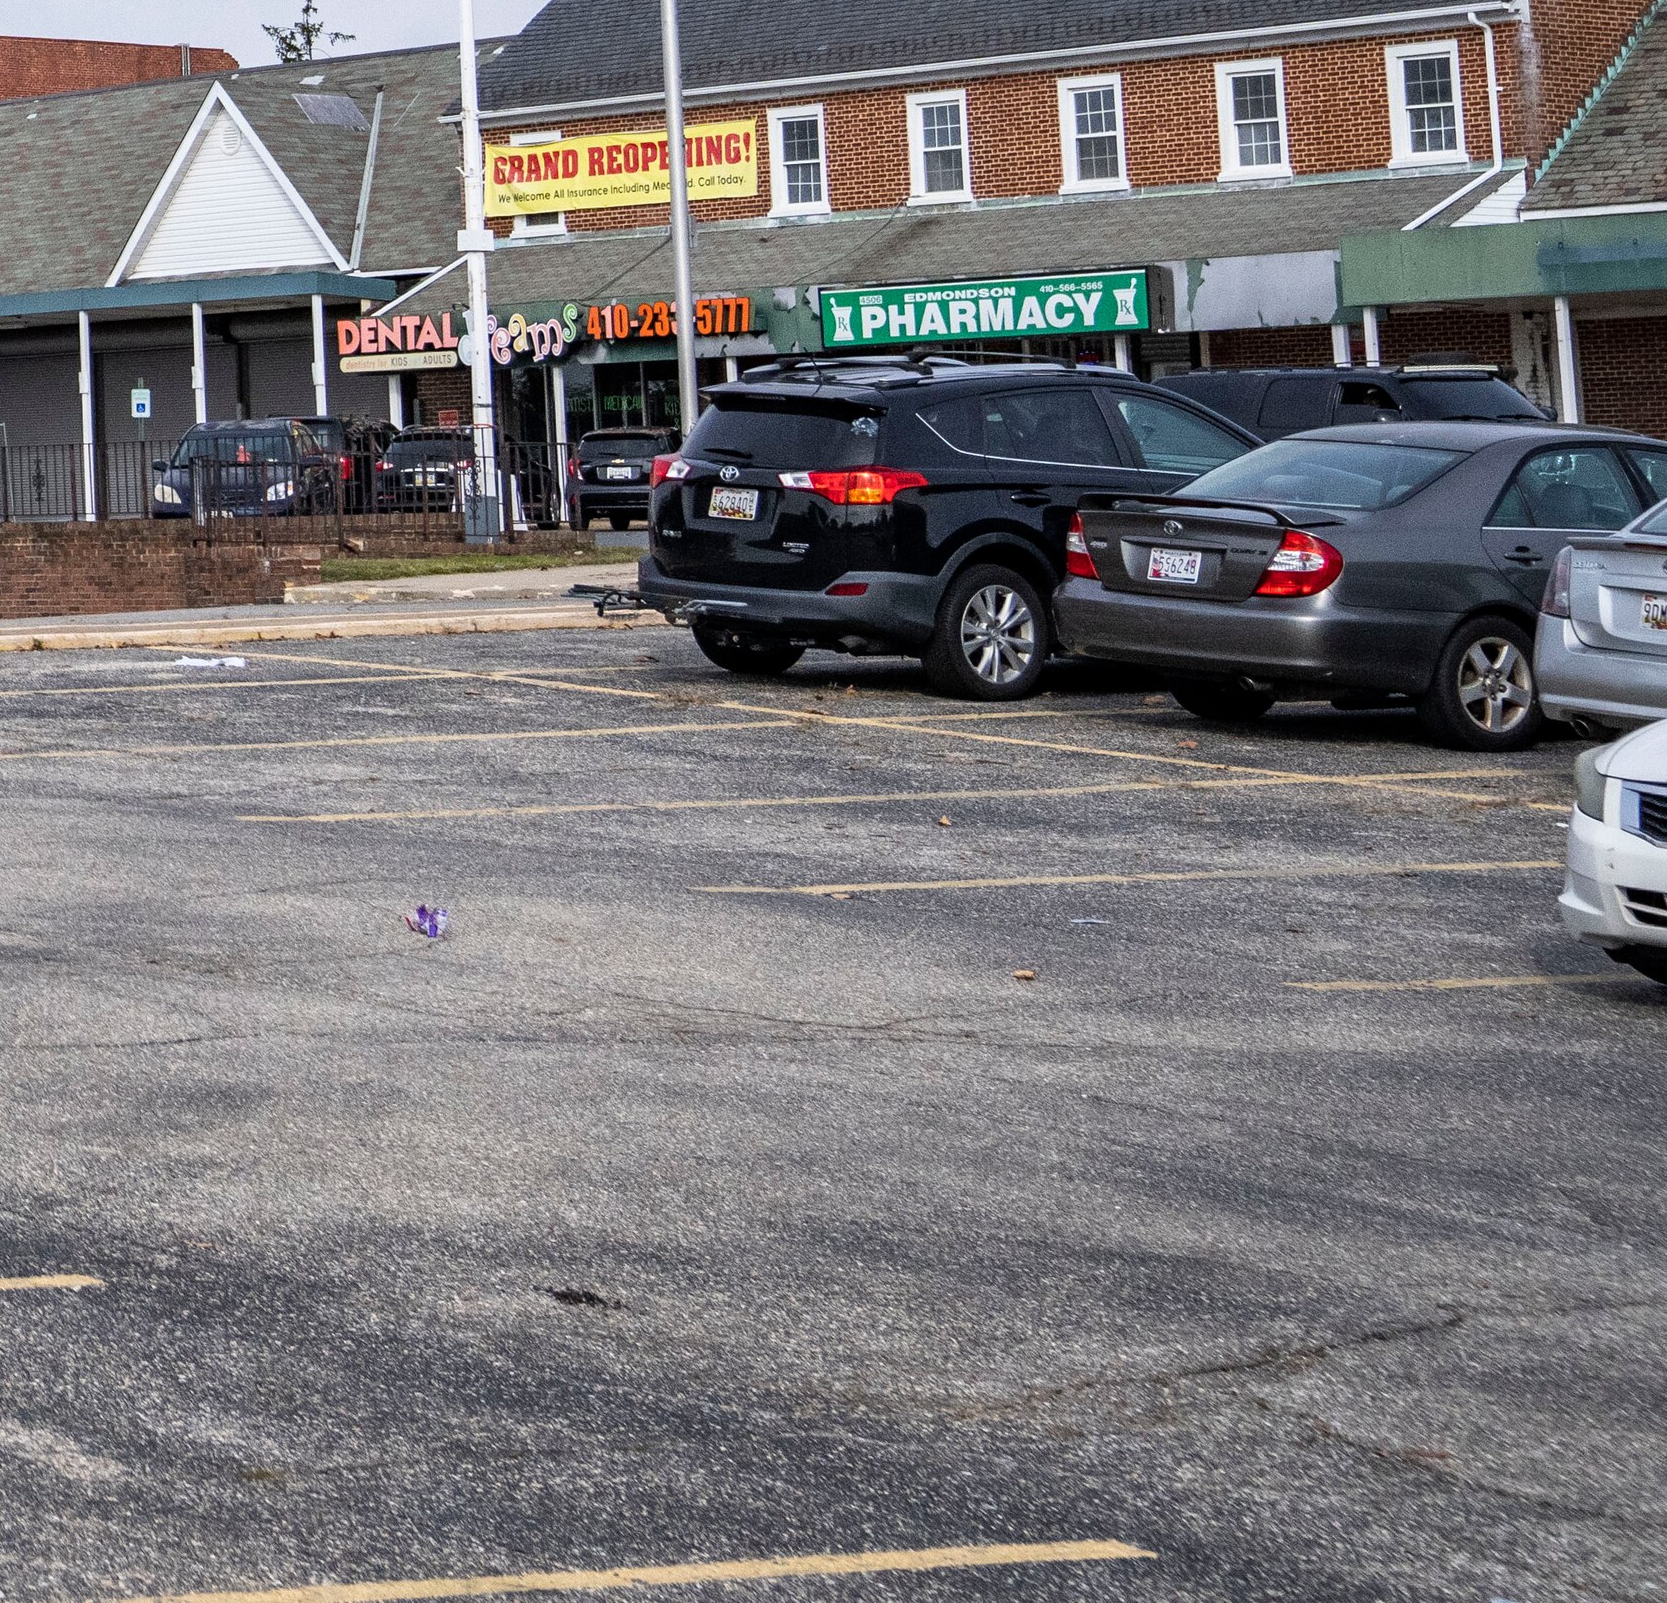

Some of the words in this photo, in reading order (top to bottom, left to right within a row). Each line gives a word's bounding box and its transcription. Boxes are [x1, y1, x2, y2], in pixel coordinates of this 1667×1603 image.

[492, 148, 579, 186] GRAND
[498, 193, 512, 204] We
[513, 189, 551, 203] Welcome
[553, 188, 565, 199] All
[567, 186, 608, 197] Insurance
[610, 182, 650, 196] Including
[652, 178, 696, 191] Meid.
[698, 176, 716, 187] Call
[860, 297, 883, 305] 4506
[903, 286, 1016, 303] EDMONDSON
[861, 291, 1103, 339] PHARMACY
[336, 311, 459, 355] DENTAL
[390, 357, 409, 367] KIDS
[422, 354, 452, 366] ADULTS
